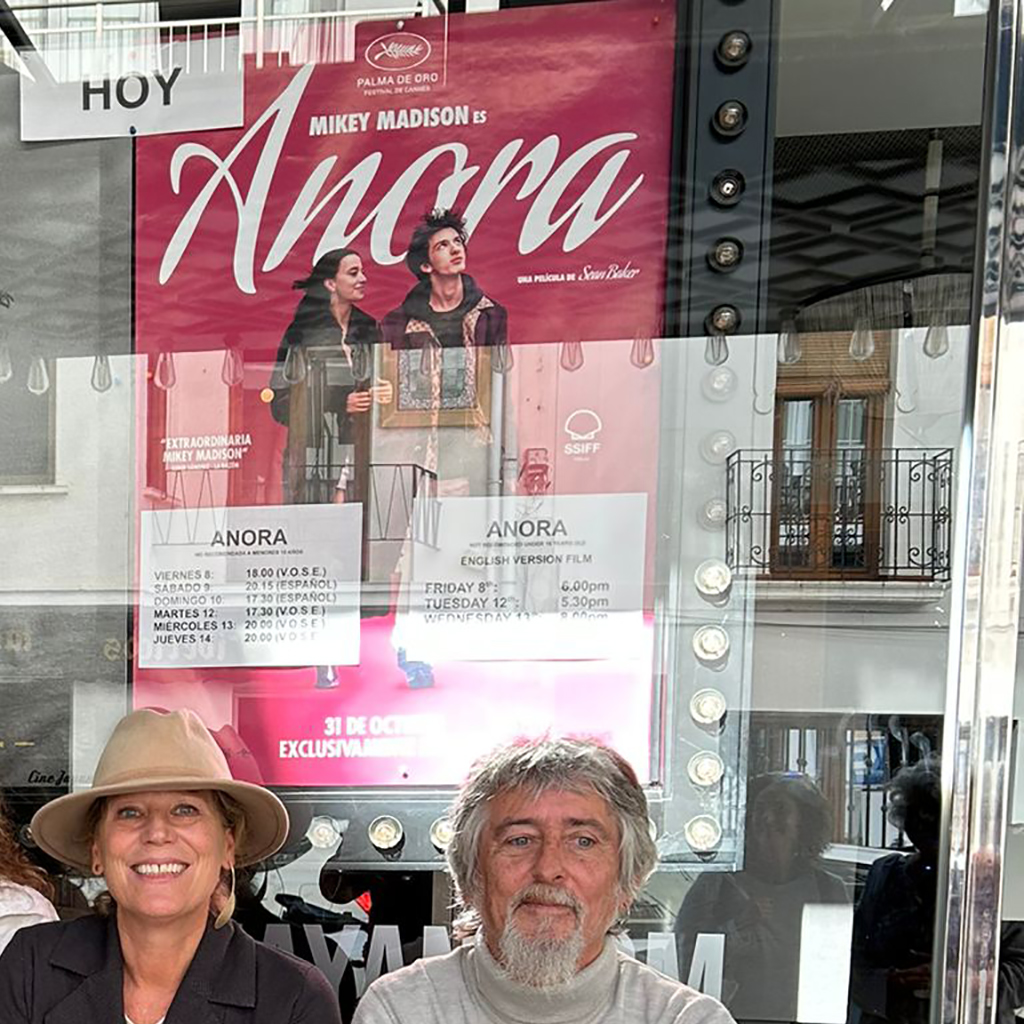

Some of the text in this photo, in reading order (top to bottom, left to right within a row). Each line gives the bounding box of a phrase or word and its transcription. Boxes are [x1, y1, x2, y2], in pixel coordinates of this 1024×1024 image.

[356, 72, 439, 88] PALMA DE ORO
[82, 67, 182, 111] HOY
[309, 105, 488, 136] MIKEY MADISON ES
[159, 64, 645, 295] Anora
[564, 442, 602, 455] SSIFF
[163, 451, 193, 462] MIKEY
[486, 519, 568, 539] ANORA
[211, 528, 287, 547] ANORA
[461, 554, 592, 567] ENGLISH VERSION FILM
[154, 570, 202, 581] VIERNES
[246, 568, 273, 578] 18.00
[246, 578, 337, 591] 20.15 (ESPAÑOL)
[425, 582, 474, 595] FRIDAY
[561, 580, 610, 593] 6.00pm
[154, 595, 206, 607] DOMINGO
[276, 592, 337, 604] (ESPAÑOL)
[425, 598, 489, 610] TUESDAY
[561, 597, 610, 609] 5.30pm
[154, 608, 218, 619] MARTES 12:
[245, 607, 273, 617] 17.30
[221, 621, 236, 631] 13:
[153, 634, 196, 645] JUEVES
[324, 716, 342, 736] 31
[346, 715, 366, 735] DE
[28, 769, 54, 783] Cine
